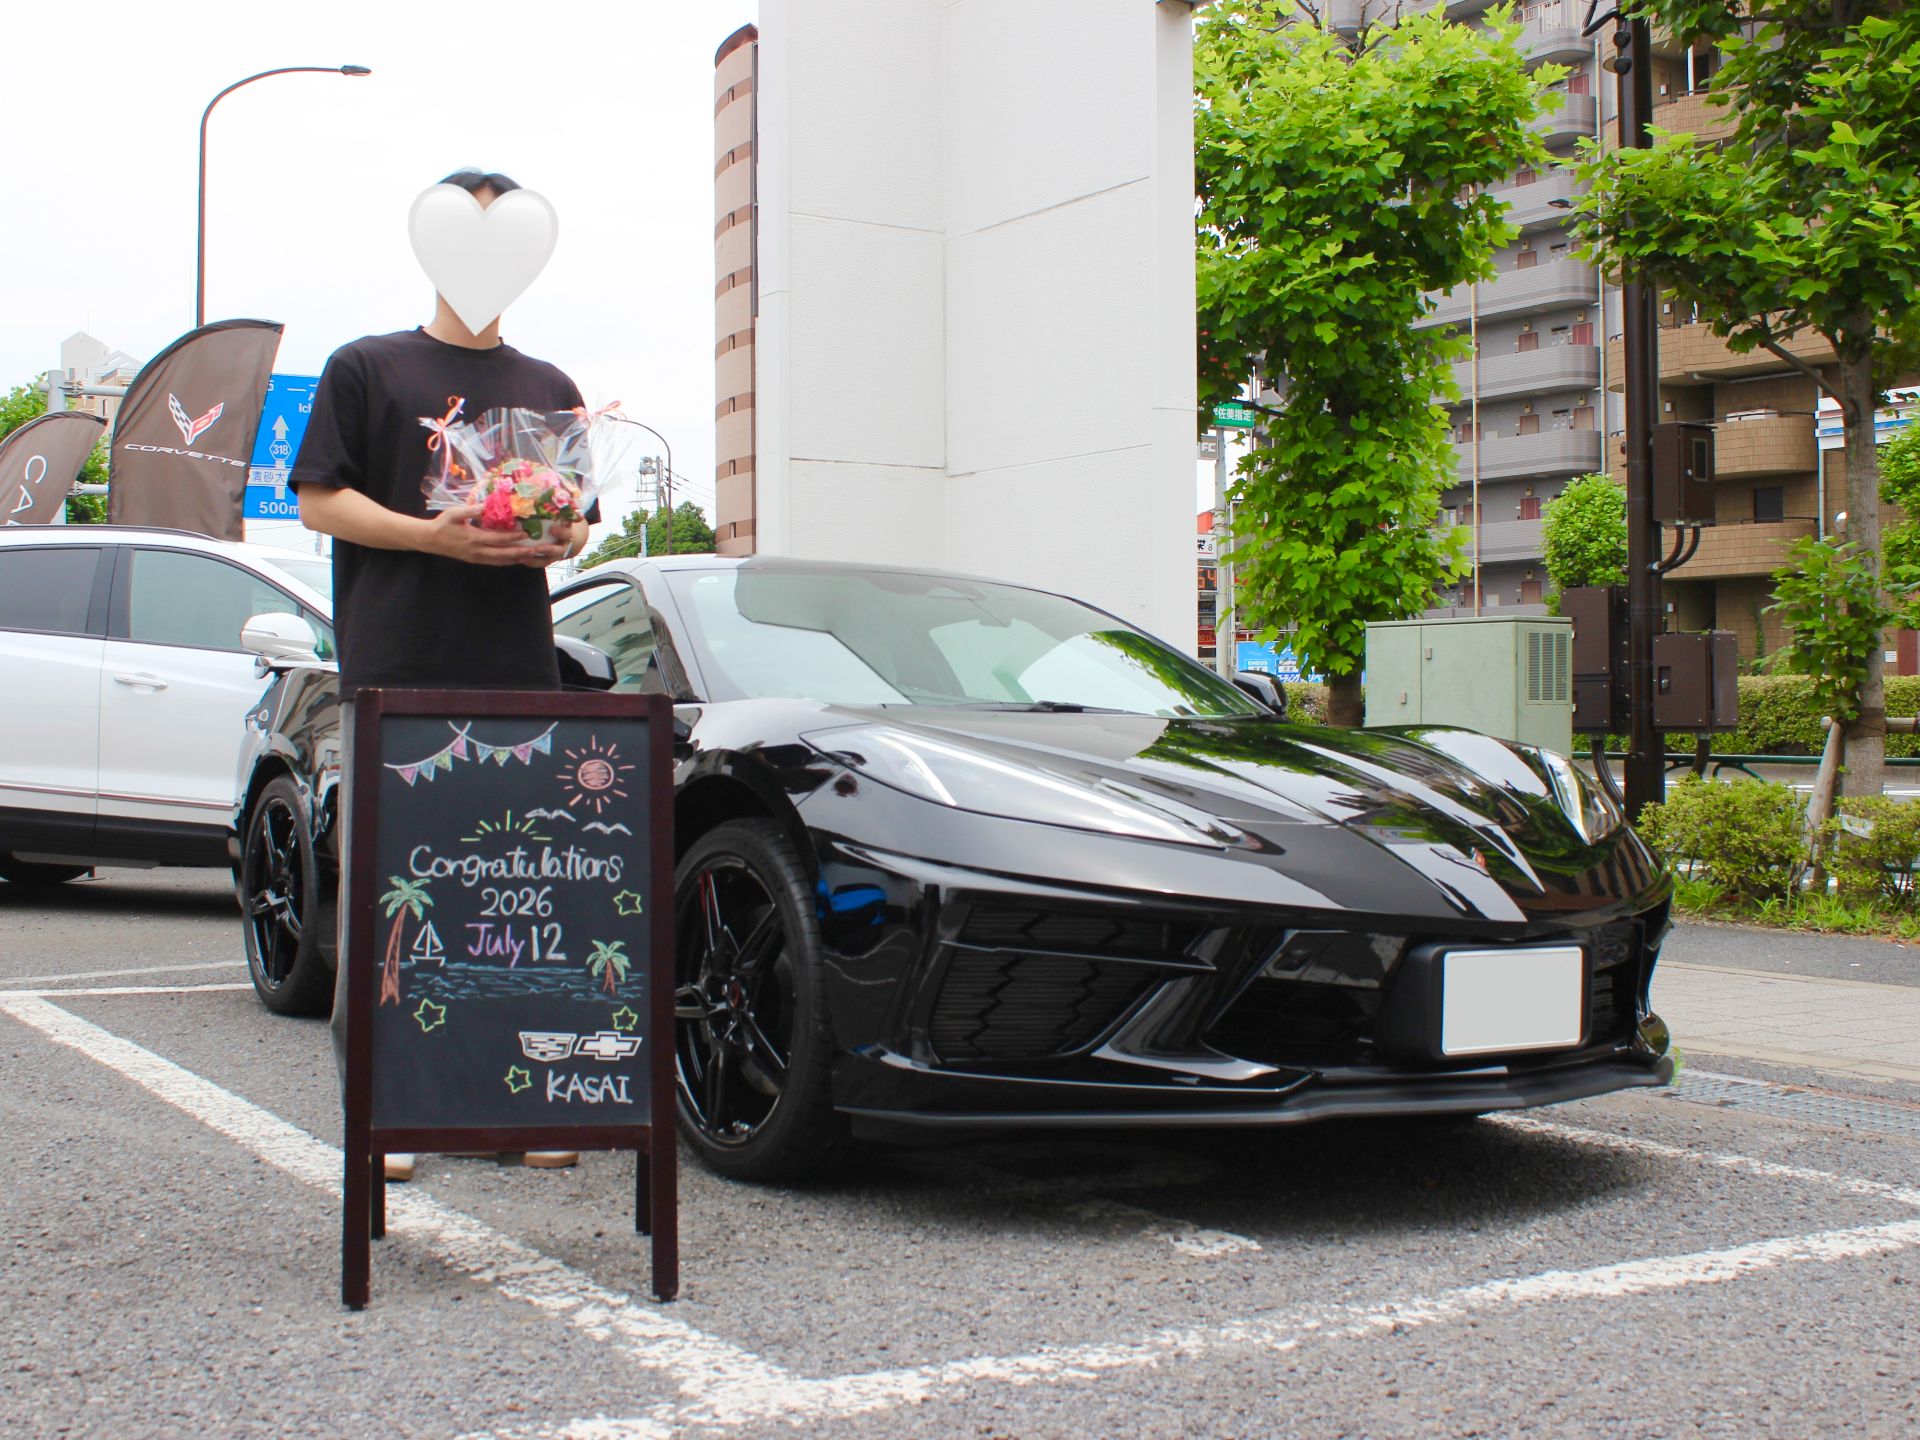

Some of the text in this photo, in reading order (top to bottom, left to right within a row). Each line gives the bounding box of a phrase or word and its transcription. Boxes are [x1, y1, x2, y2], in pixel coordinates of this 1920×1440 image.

[124, 443, 246, 467] CORVETTE
[273, 444, 289, 455] 318
[7, 455, 47, 526] CA
[259, 501, 299, 515] 500m
[409, 844, 624, 888] Congratulations
[480, 885, 553, 918] 2026
[465, 922, 567, 969] July 12
[546, 1068, 633, 1104] KASAI
